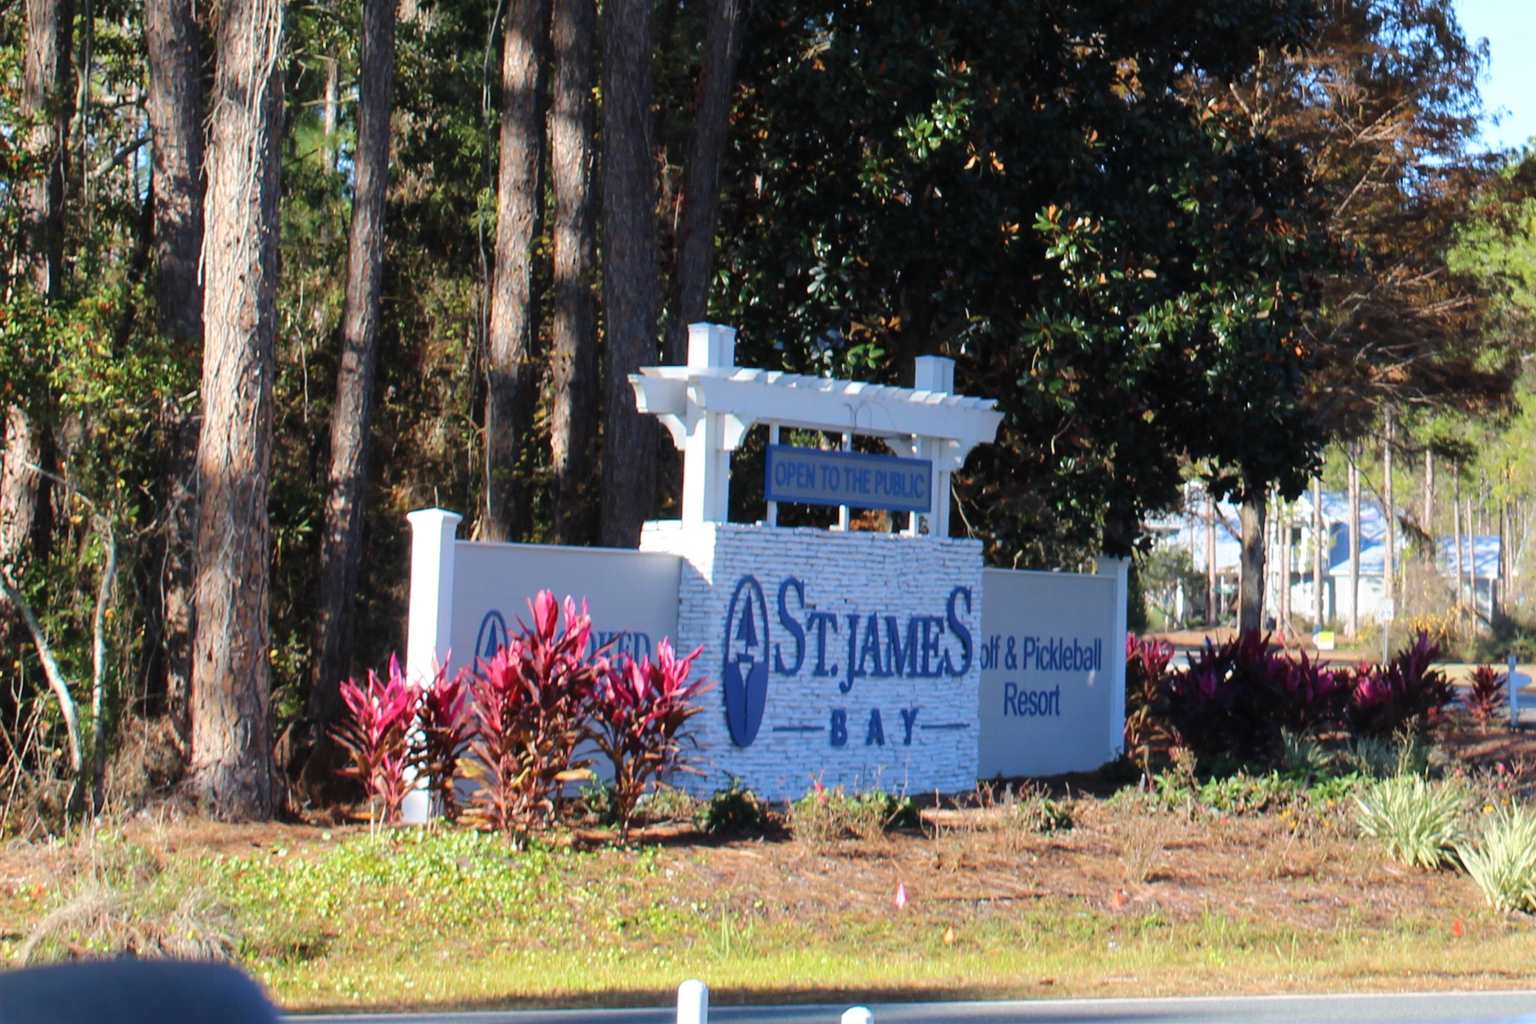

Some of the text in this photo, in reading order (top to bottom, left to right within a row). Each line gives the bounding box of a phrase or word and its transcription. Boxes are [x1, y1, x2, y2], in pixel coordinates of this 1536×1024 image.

[776, 461, 925, 499] OPEN TO THE PUBLIC
[980, 635, 1102, 672] olf & Pickleball
[1004, 682, 1060, 717] Resort
